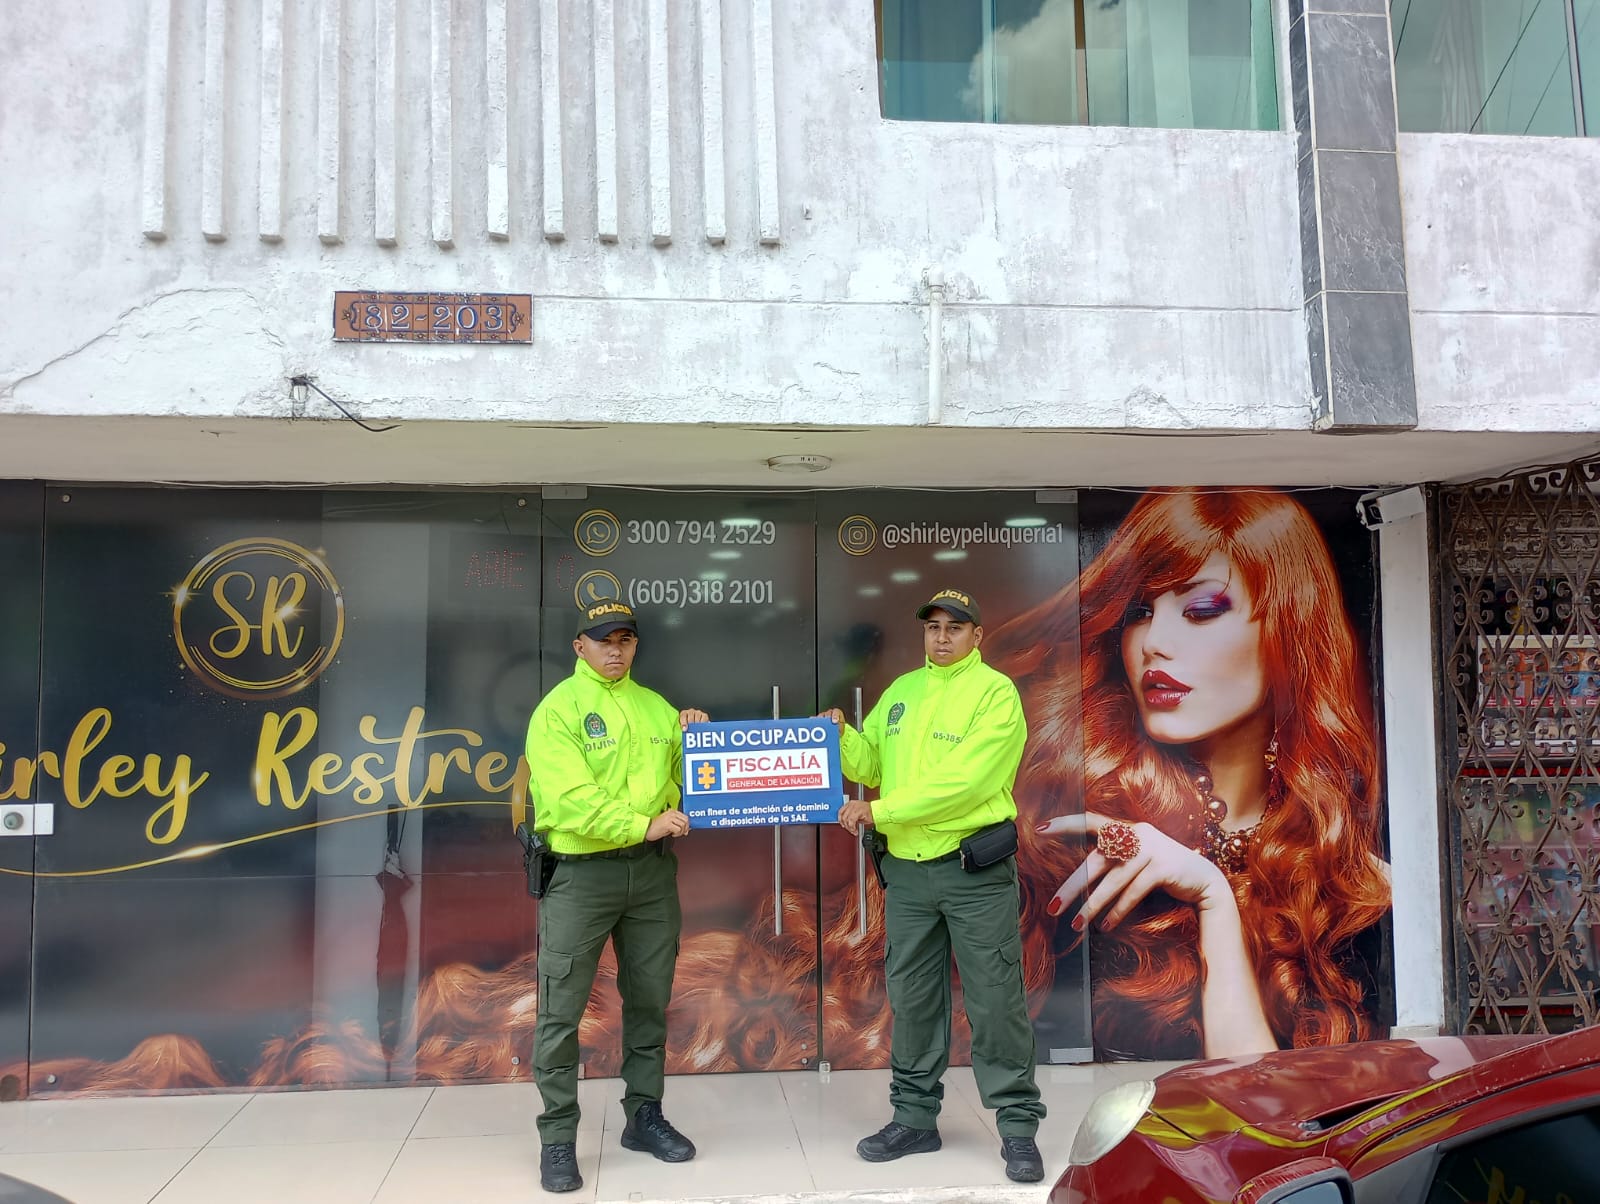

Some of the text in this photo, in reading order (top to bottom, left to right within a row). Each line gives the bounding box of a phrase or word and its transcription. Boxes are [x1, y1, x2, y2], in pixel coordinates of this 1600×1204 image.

[364, 304, 503, 331] 82-203
[627, 517, 777, 546] 300 794 2529
[881, 521, 1064, 550] @shirleypeluqueria1
[627, 578, 775, 609] (605)318 2101
[209, 571, 307, 659] SR
[588, 602, 633, 620] POLICIA
[585, 738, 617, 752] DIJIN
[685, 727, 827, 748] BIEN OCUPADO
[726, 752, 821, 773] FISCALÍA
[729, 775, 821, 787] GENERAL DE LA NACIÓN
[689, 802, 830, 817] con fines de extinción de dominio
[710, 812, 809, 827] a disposición de la SAE.
